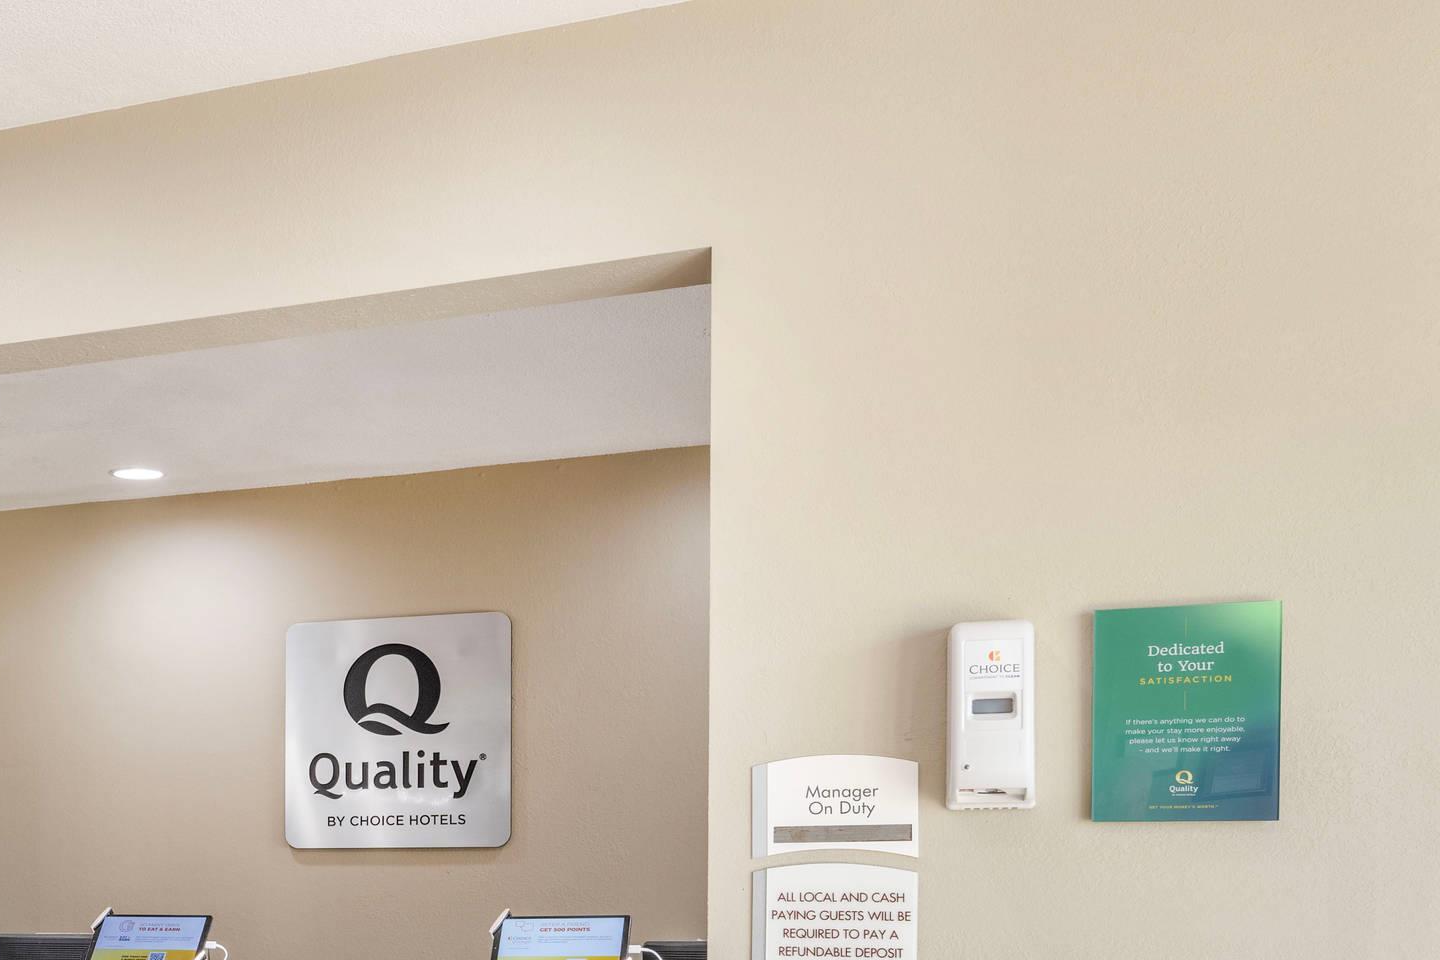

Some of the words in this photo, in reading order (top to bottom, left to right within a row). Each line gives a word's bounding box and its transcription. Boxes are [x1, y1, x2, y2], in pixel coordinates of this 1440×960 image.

[1147, 641, 1225, 657] Dedicated
[969, 664, 1020, 674] CHOICE
[1158, 661, 1173, 672] to
[1177, 660, 1215, 671] Your
[1139, 675, 1232, 685] SATISFACTION
[343, 643, 450, 736] Q
[1159, 717, 1193, 726] anything
[1200, 735, 1219, 743] right
[1175, 770, 1194, 784] Q
[806, 785, 879, 802] Manager
[1169, 785, 1199, 793] Quality
[809, 801, 832, 815] On
[840, 801, 876, 818] Duty
[327, 816, 345, 827] BY
[350, 815, 404, 826] CHOICE
[409, 814, 466, 826] HOTELS
[777, 892, 796, 902] ALL
[799, 892, 837, 902] LOCAL
[840, 892, 868, 902] AND
[871, 892, 905, 903] CASH
[771, 910, 816, 921] PAYING
[819, 910, 864, 921] GUESTS
[867, 911, 894, 921] WILL
[897, 911, 911, 922] BE
[783, 928, 840, 939] REQUIRED
[843, 929, 860, 939] TO
[863, 929, 886, 939] PAY
[889, 930, 899, 940] A
[778, 946, 851, 957] REFUNDABLE
[855, 948, 904, 958] DEPOSIT
